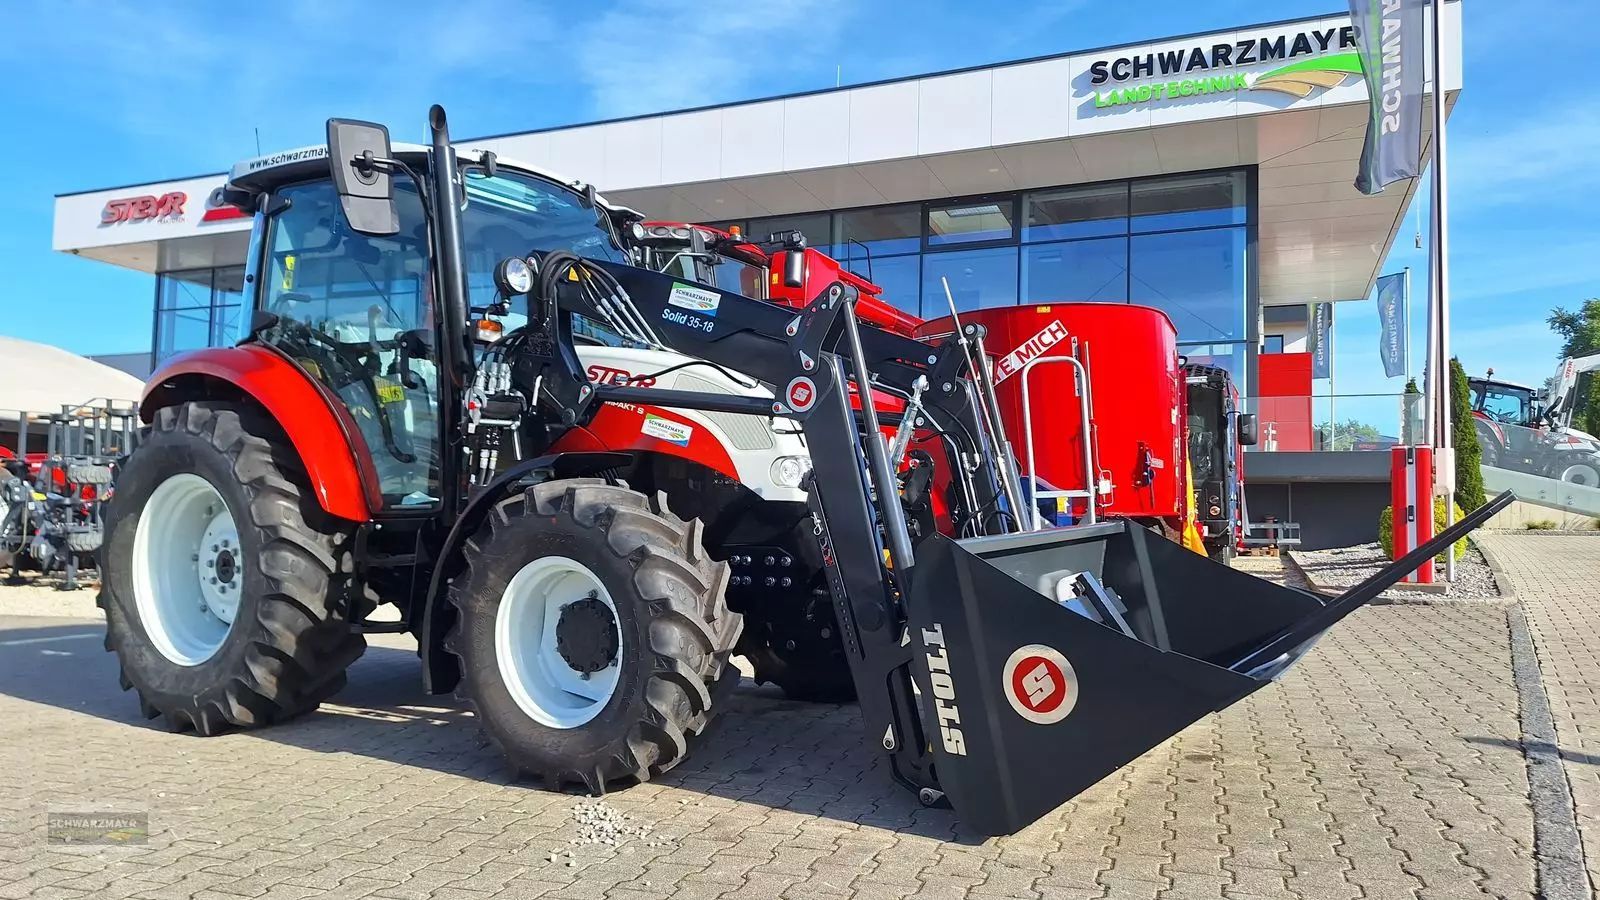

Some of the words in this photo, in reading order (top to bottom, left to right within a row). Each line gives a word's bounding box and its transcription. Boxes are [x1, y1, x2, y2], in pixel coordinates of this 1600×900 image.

[1095, 73, 1249, 107] LANDTECHNIK
[102, 192, 187, 223] STEYR
[675, 288, 713, 303] SCHWARZMAYR
[662, 308, 688, 324] Solid
[687, 316, 714, 332] 35-18
[1014, 322, 1067, 364] MICH
[637, 407, 645, 415] S
[648, 419, 685, 434] SCHWARZMAYR
[921, 623, 967, 756] STOLL
